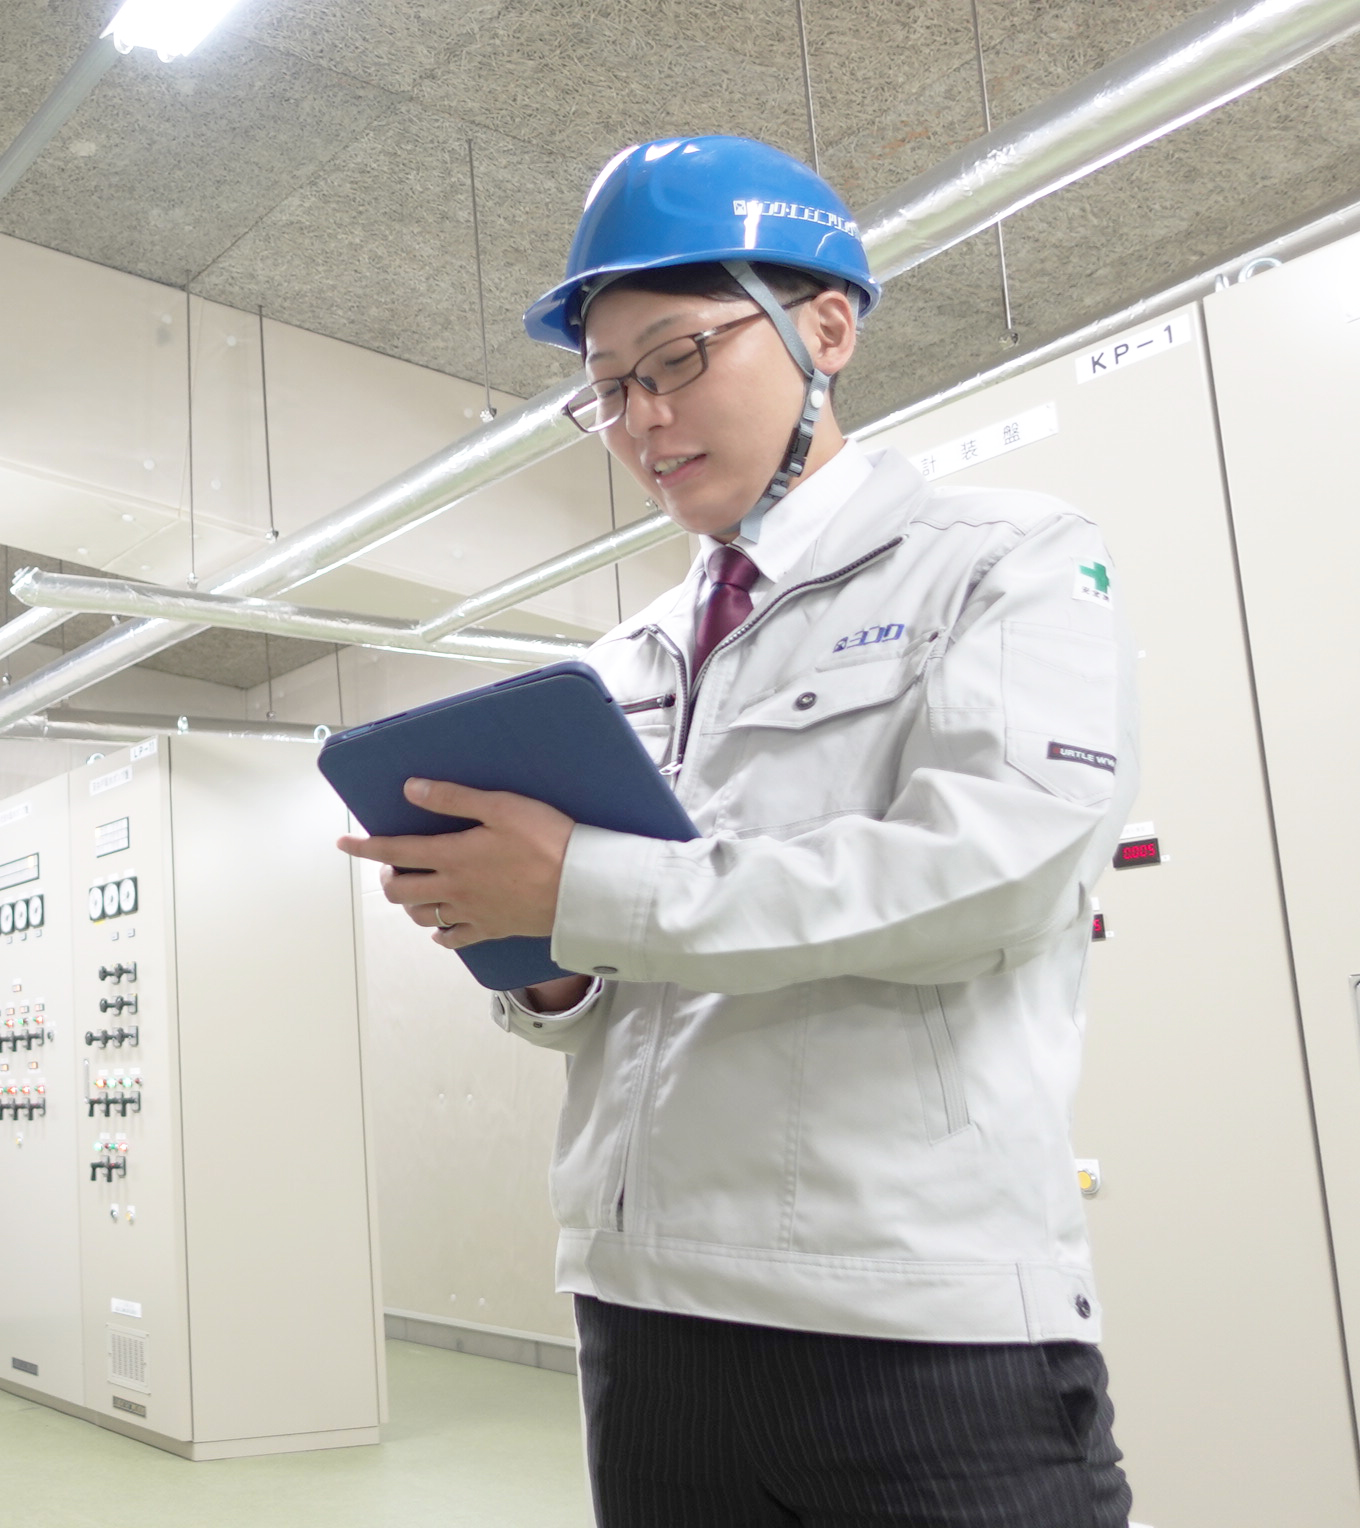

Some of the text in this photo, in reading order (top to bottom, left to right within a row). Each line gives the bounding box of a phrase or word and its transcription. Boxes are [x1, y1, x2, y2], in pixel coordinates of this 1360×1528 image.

[1090, 323, 1175, 375] KP-1
[920, 421, 1022, 477] 計装盤
